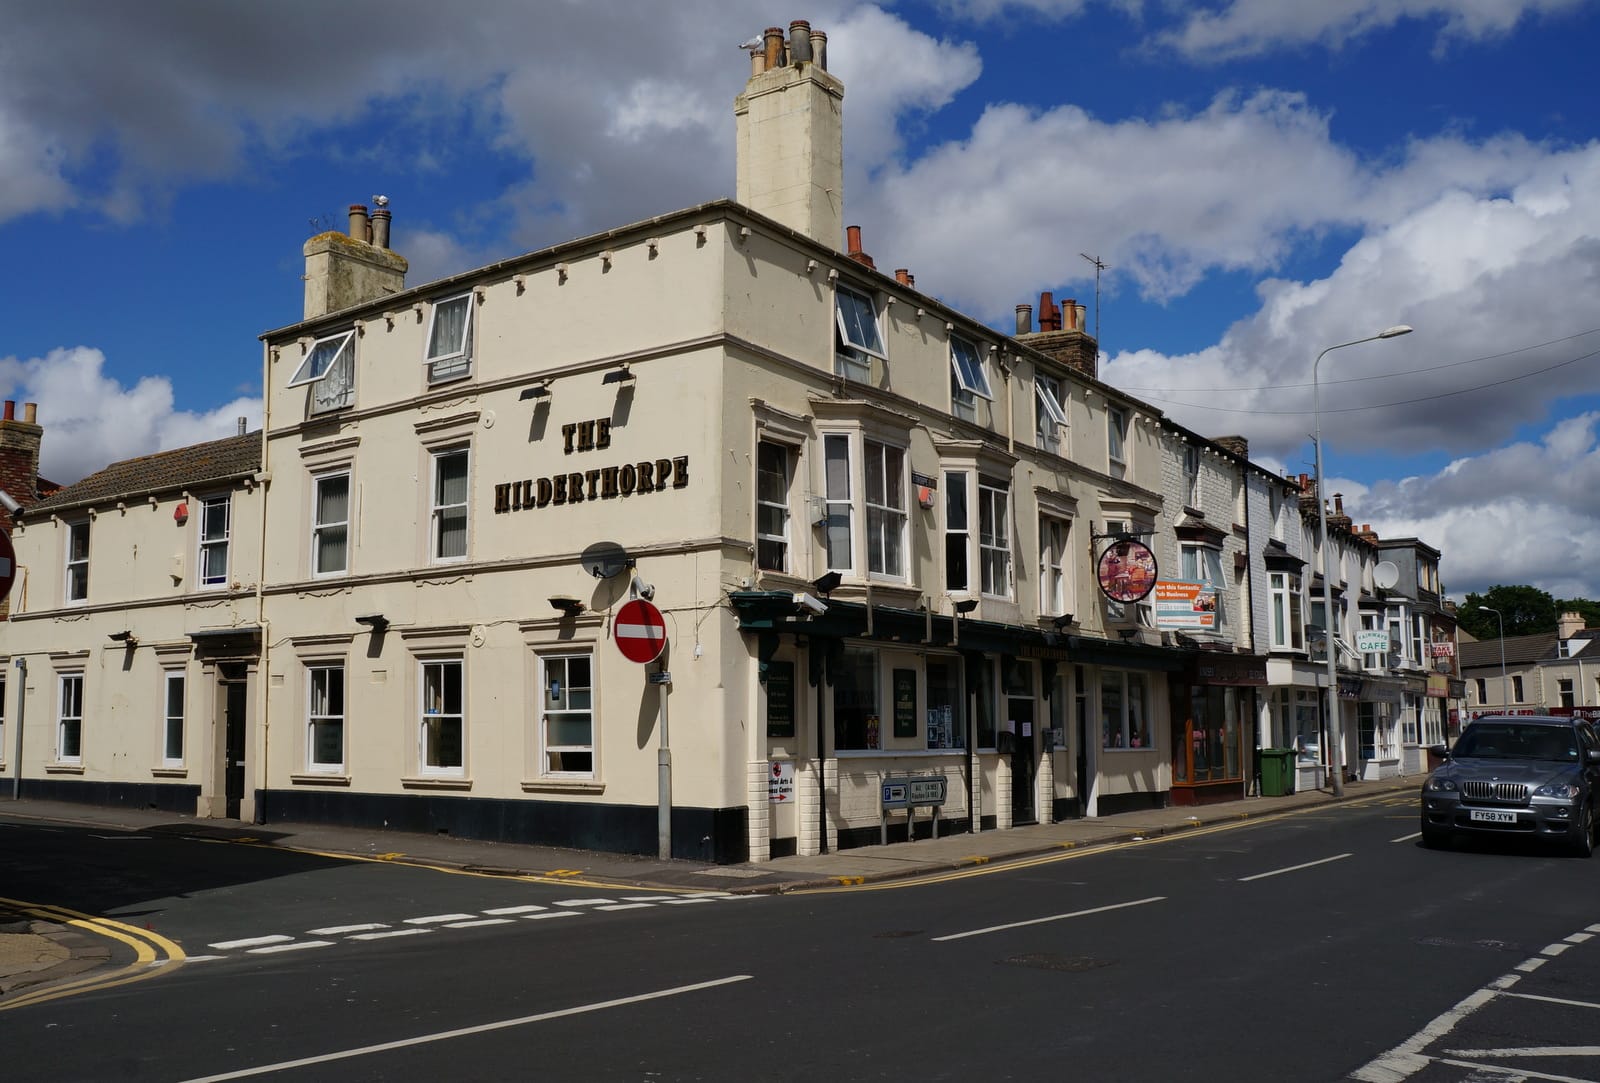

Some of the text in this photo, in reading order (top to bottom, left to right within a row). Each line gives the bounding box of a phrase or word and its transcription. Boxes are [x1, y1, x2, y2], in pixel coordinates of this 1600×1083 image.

[562, 417, 611, 455] THE
[494, 455, 689, 514] HILDERTHORPE
[1359, 632, 1388, 641] FAIRWAYS
[1360, 642, 1387, 650] CAFE
[1475, 811, 1513, 822] FY58 XYW
